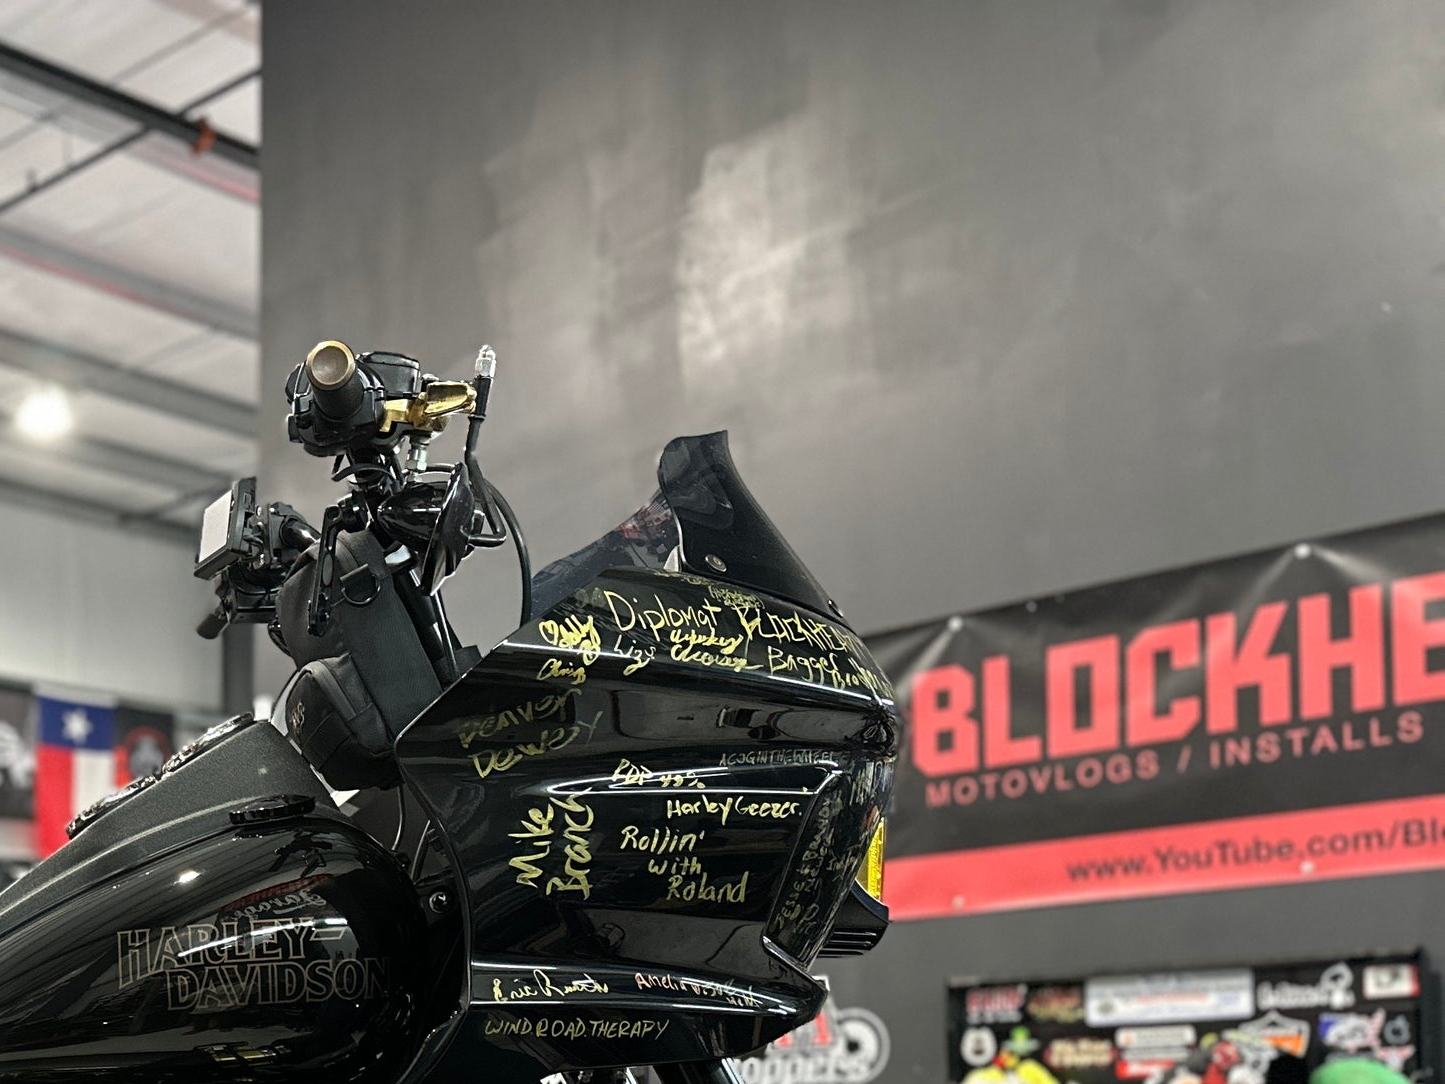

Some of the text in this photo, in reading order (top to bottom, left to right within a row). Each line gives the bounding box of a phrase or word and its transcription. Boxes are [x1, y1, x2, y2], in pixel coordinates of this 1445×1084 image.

[604, 590, 721, 642] Diplomat
[925, 748, 1160, 809] MOTOVLOGS
[1209, 711, 1425, 770] INSTALLS
[648, 857, 702, 876] with
[1066, 818, 1445, 883] www.YouTube.com/Bl
[667, 871, 750, 903] Roland
[165, 957, 391, 1011] DAVIDSON
